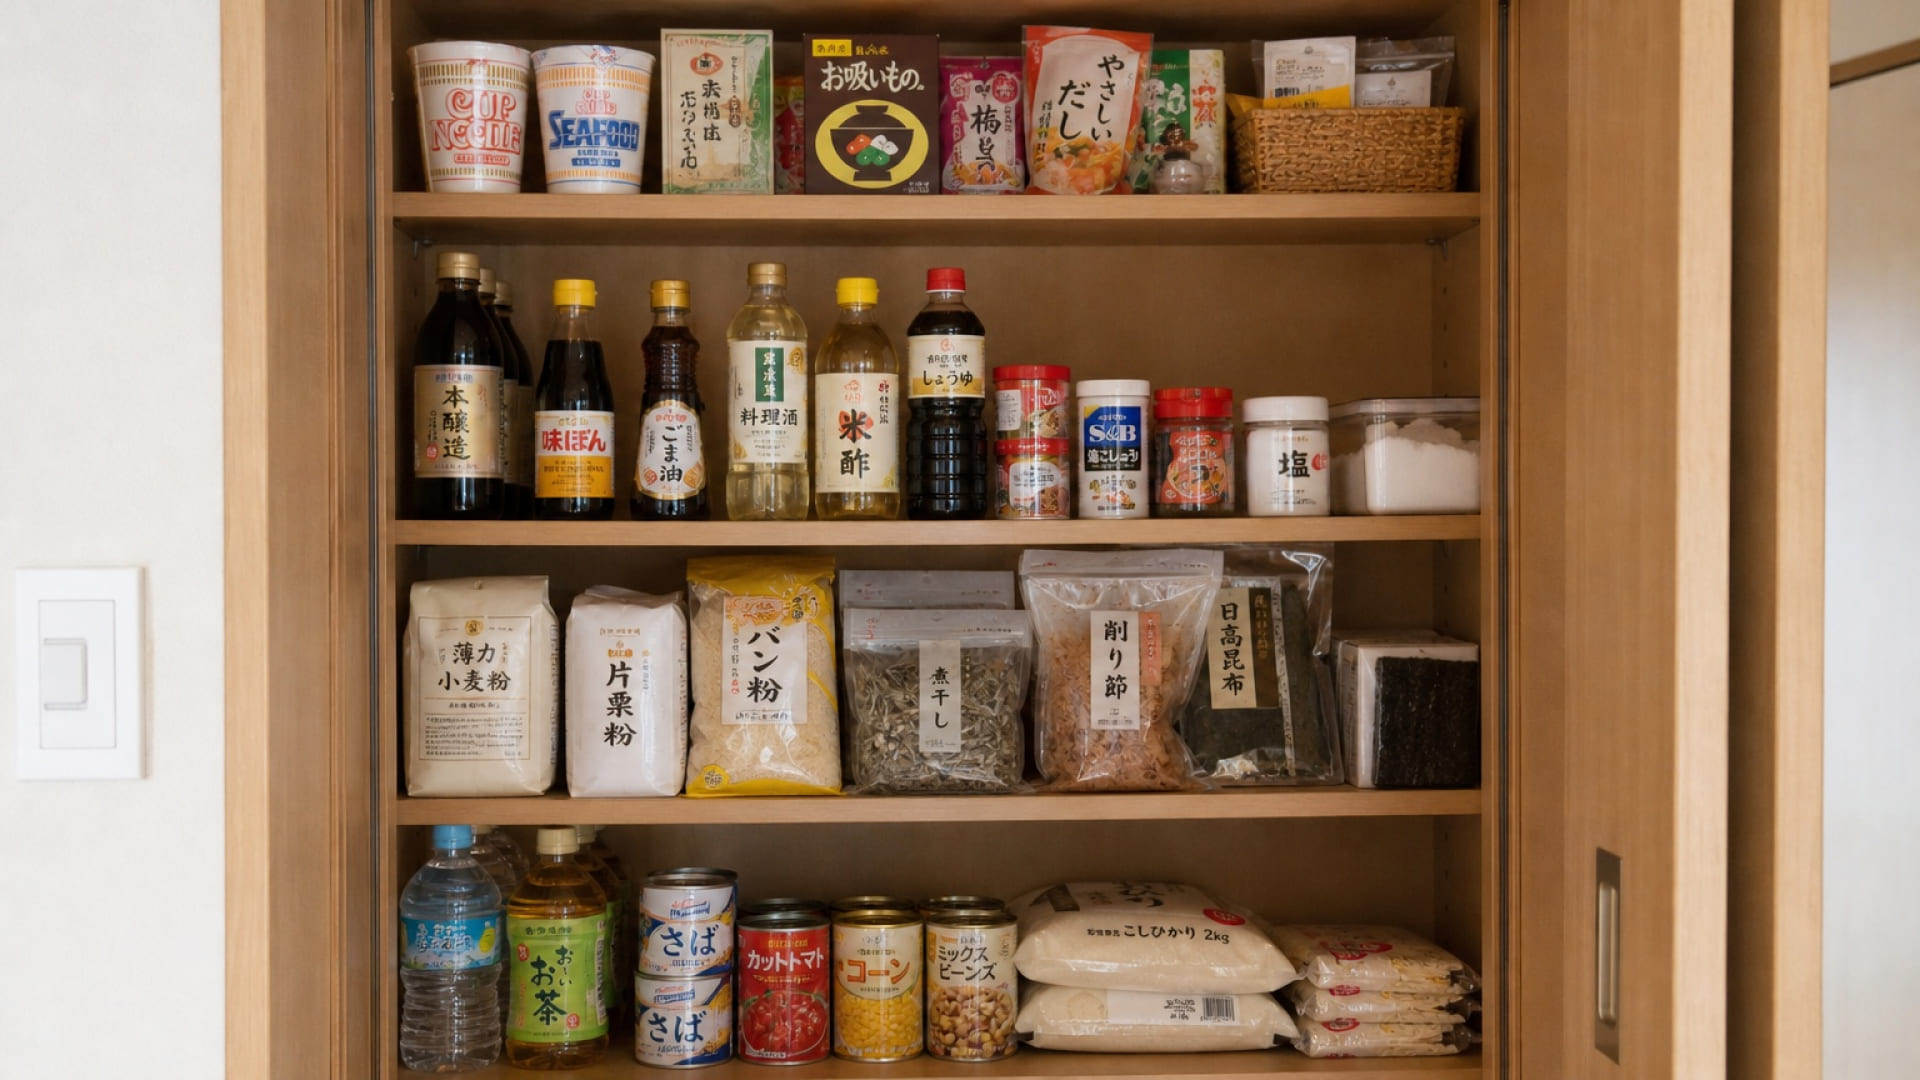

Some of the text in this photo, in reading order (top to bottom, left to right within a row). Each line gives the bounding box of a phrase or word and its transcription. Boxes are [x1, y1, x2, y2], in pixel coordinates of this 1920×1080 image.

[445, 88, 516, 119] CUP
[1058, 79, 1091, 140] だし
[1091, 54, 1125, 141] やさしい
[548, 110, 640, 151] SEAFOOD
[442, 384, 471, 460] 本醸造
[740, 407, 798, 426] 料理酒
[1089, 424, 1136, 442] S&B
[660, 424, 683, 482] ごま油
[839, 408, 872, 479] 米酢
[1278, 450, 1310, 478] 塩
[452, 642, 496, 665] 薄力
[1104, 620, 1128, 700] 削り節
[1220, 602, 1246, 696] 日高昆布
[438, 670, 511, 692] 小麦粉
[931, 666, 950, 729] 煮干し
[603, 660, 637, 747] 片栗粉
[660, 924, 720, 957] さば
[1124, 925, 1196, 939] こしひかり
[1204, 929, 1230, 944] 2kg
[747, 948, 824, 972] カットトマト
[938, 946, 989, 963] ミックス
[939, 962, 997, 981] ビーンズ
[530, 955, 567, 1026] お茶
[648, 1010, 707, 1044] さば
